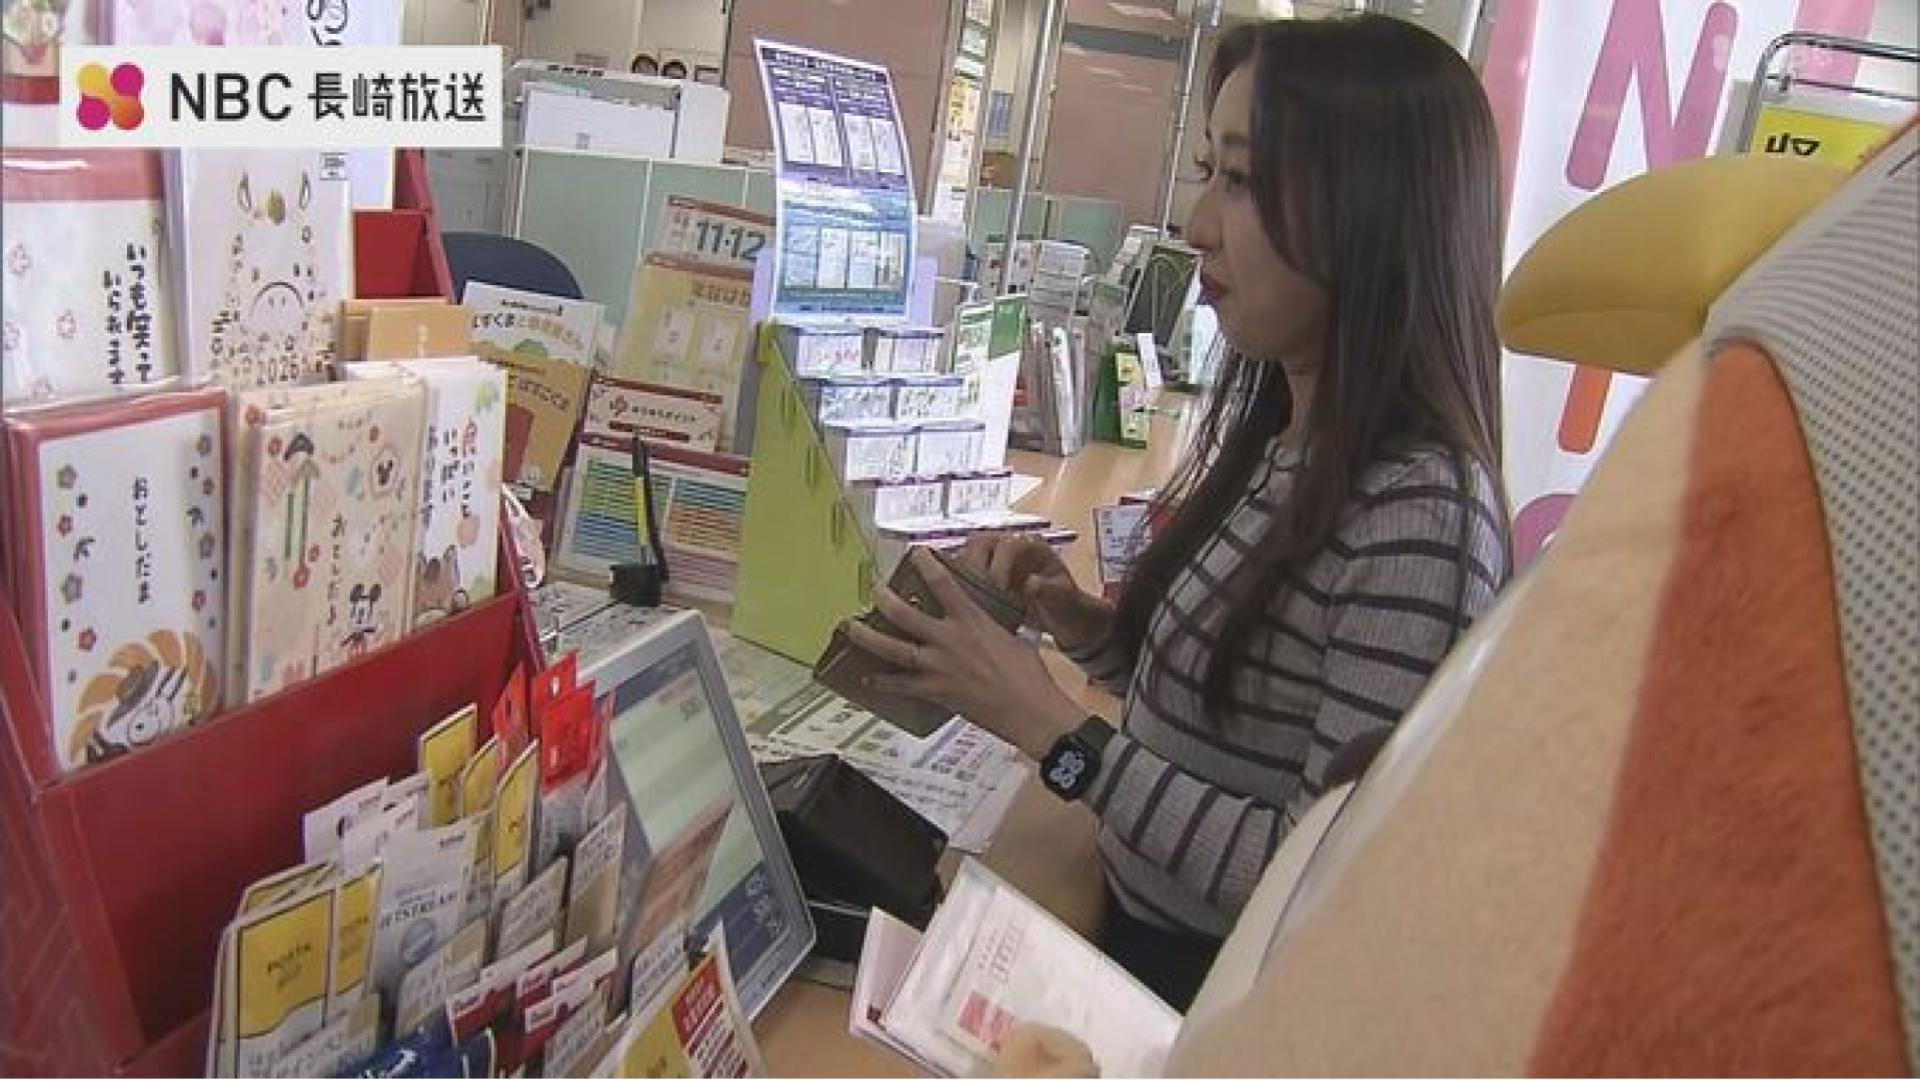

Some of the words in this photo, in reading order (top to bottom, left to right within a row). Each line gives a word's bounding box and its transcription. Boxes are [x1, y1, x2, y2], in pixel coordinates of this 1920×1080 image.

[132, 476, 151, 605] おとしだま
